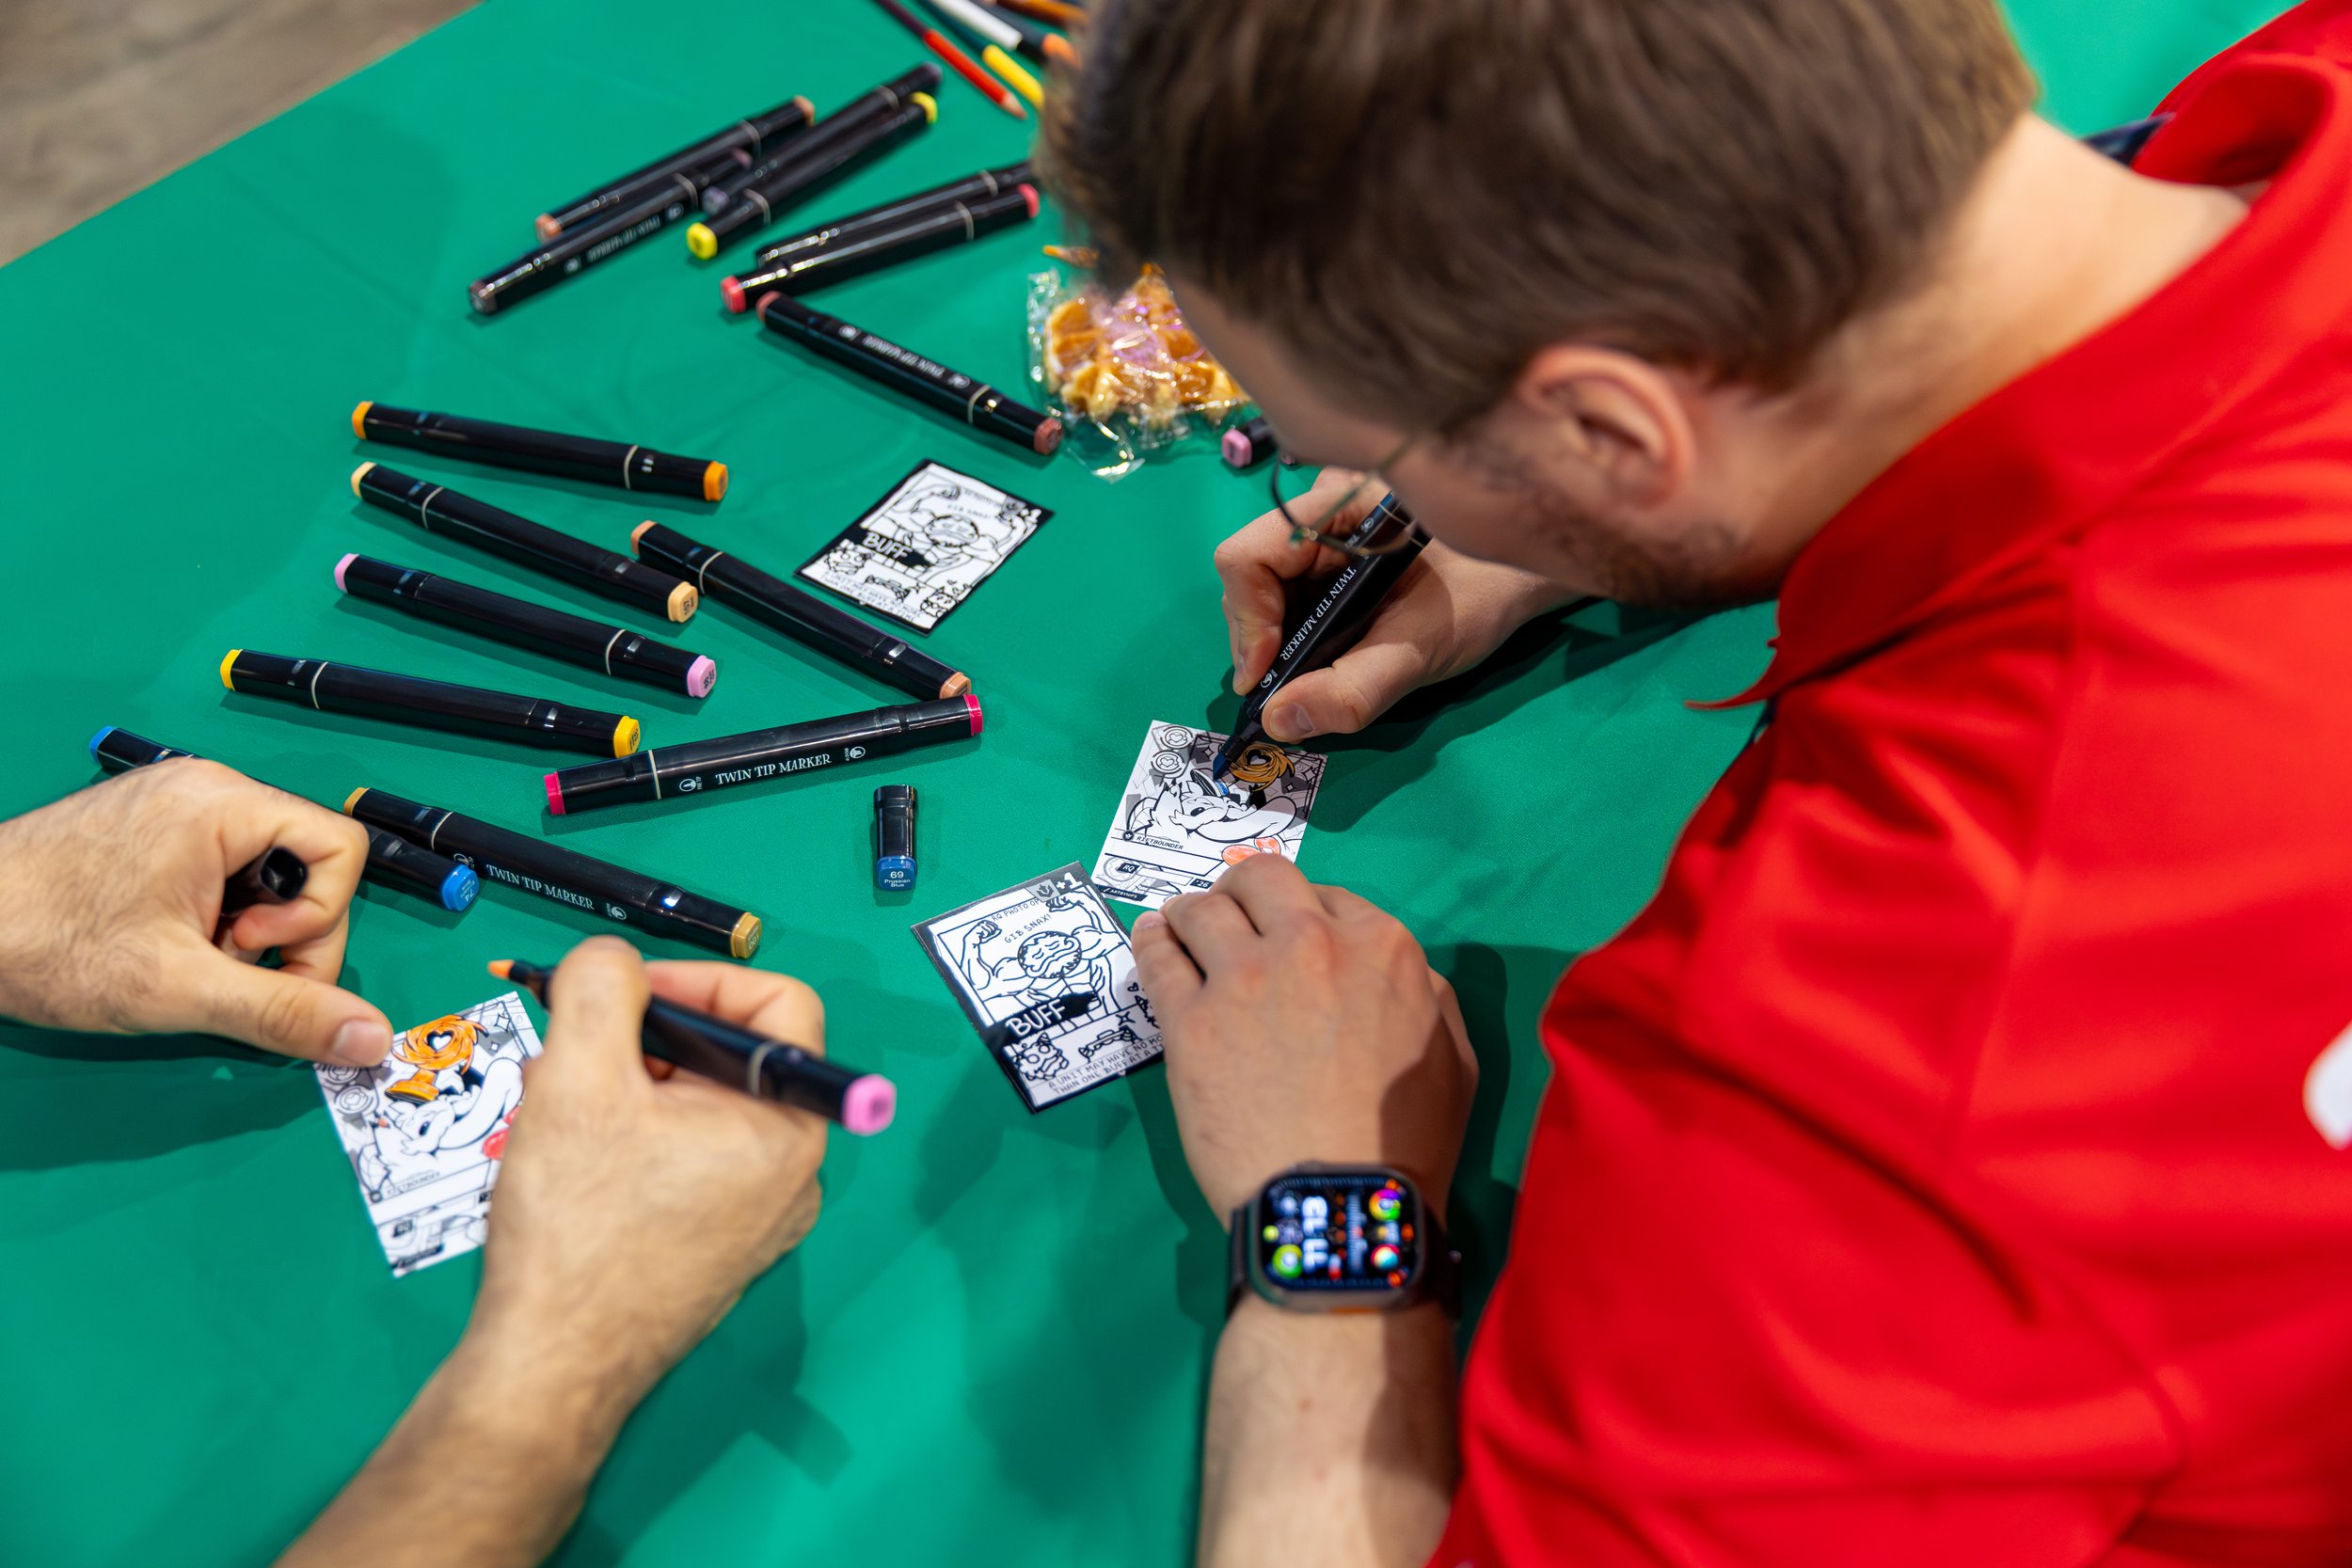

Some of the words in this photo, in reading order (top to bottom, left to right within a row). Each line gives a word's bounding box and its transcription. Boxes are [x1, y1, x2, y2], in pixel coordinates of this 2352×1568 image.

[863, 531, 914, 561] BUFF
[1329, 566, 1357, 599] TWIN
[1316, 598, 1332, 619] TIP
[1279, 616, 1318, 660] MARKER
[715, 768, 752, 784] TWIN
[754, 764, 776, 778] TIP
[779, 753, 832, 774] MARKER
[1136, 836, 1184, 849] RIFTBOUNDER
[485, 863, 520, 885] TWIN
[521, 876, 542, 893] TIP
[545, 883, 596, 911] MARKER
[1057, 872, 1083, 890] +1
[991, 912, 1003, 922] RQ
[1003, 903, 1029, 917] PHOTO
[1004, 929, 1024, 943] GIB
[1024, 913, 1052, 932] SNAX!
[1006, 999, 1066, 1036] BUFF
[1054, 1080, 1080, 1095] THAN
[1082, 1071, 1100, 1084] ONE
[1104, 1061, 1127, 1074] BUFF
[1129, 1054, 1143, 1064] AT
[1056, 1069, 1083, 1085] UNIT
[1086, 1059, 1105, 1073] MAY
[1107, 1049, 1133, 1064] HAVE
[1134, 1042, 1148, 1053] NO
[1149, 1035, 1165, 1046] MO
